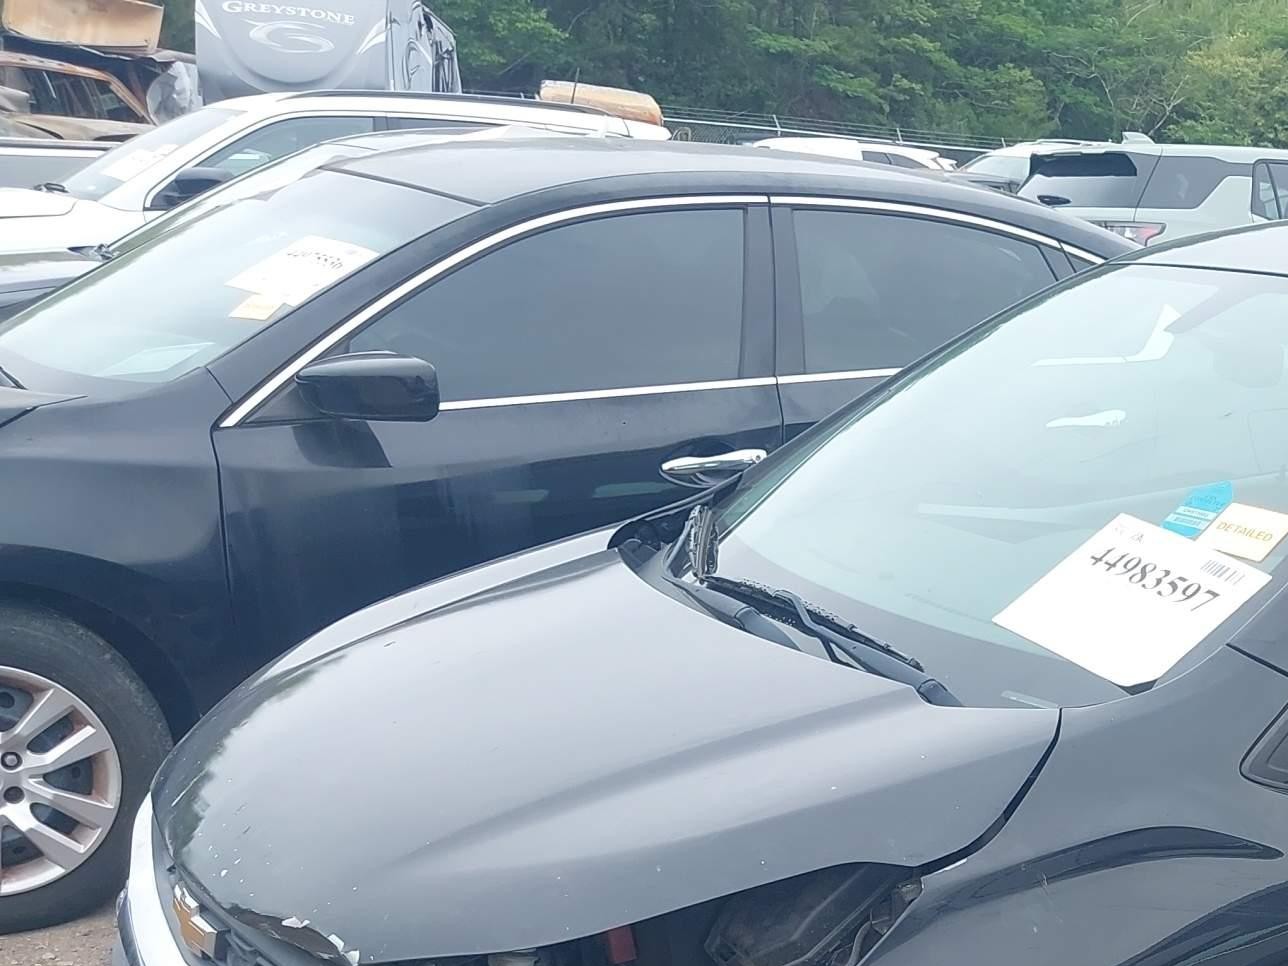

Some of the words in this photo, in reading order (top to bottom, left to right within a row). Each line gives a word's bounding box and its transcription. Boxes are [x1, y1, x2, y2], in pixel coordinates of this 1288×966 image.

[222, 0, 356, 25] GREYSTONE
[1216, 521, 1273, 543] DETAILED
[1090, 547, 1220, 611] 44983597
